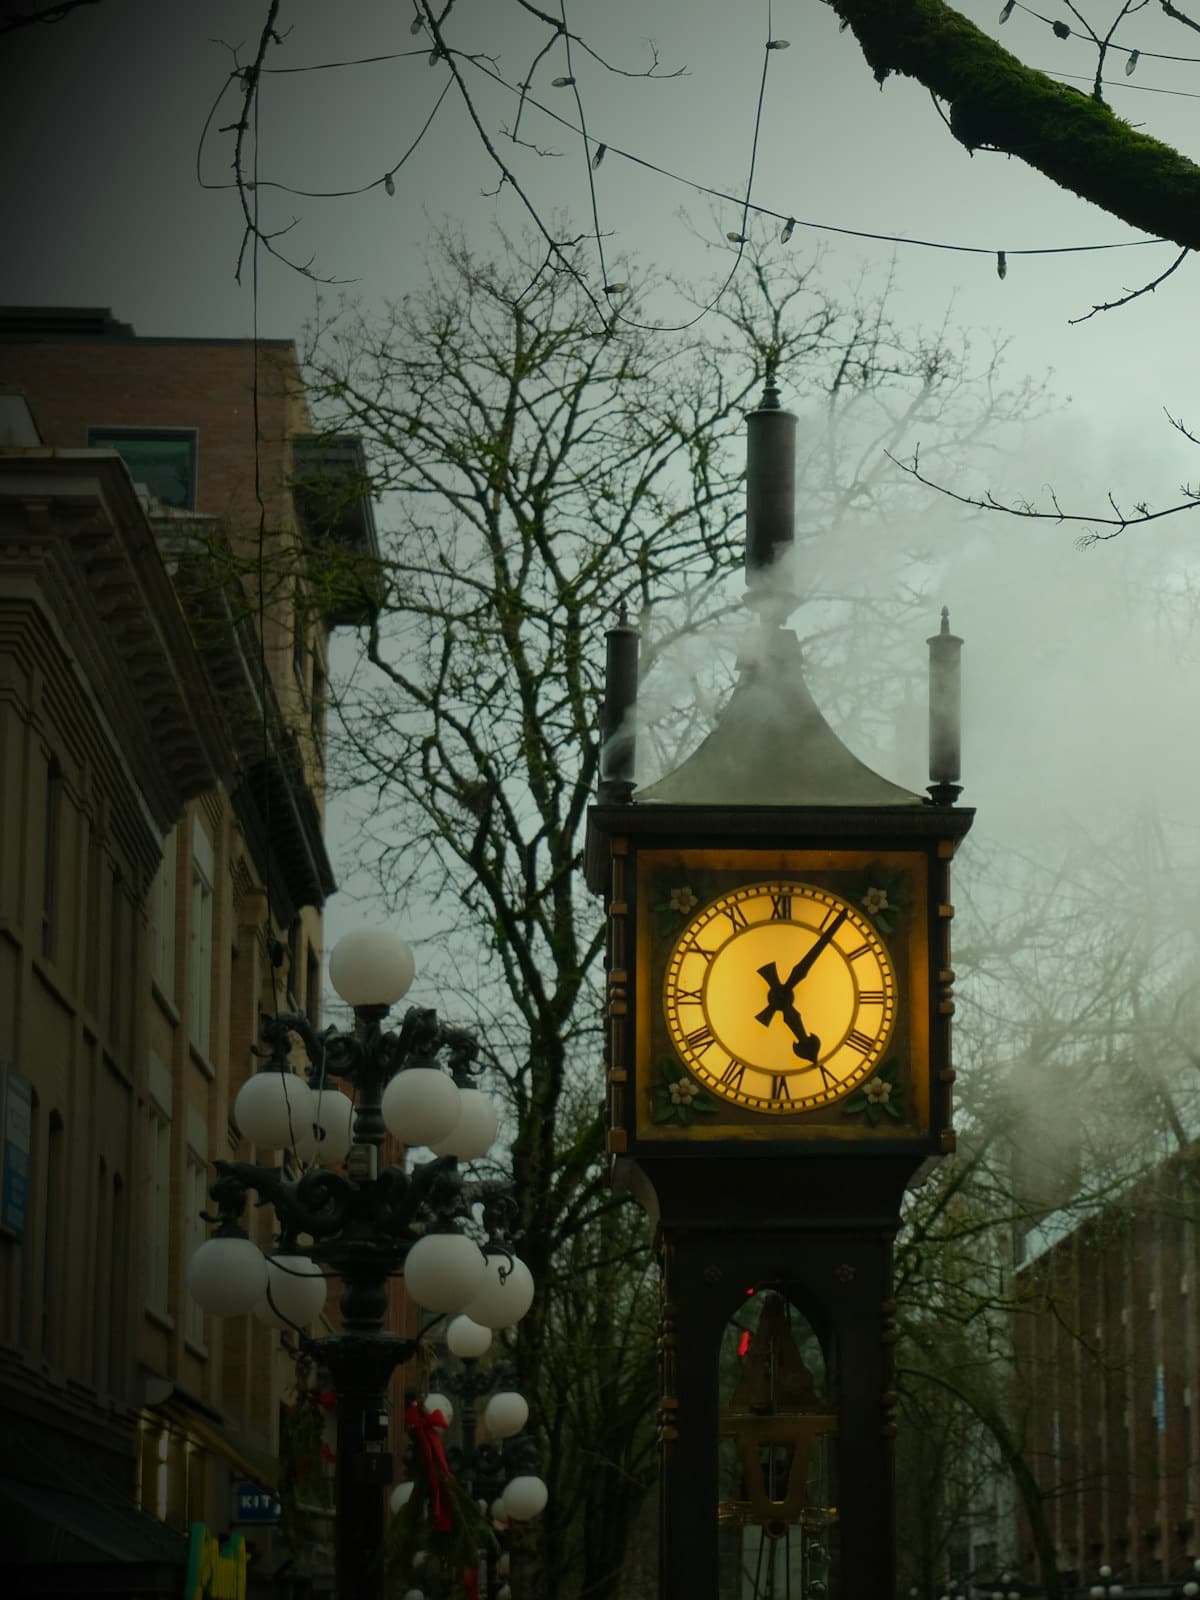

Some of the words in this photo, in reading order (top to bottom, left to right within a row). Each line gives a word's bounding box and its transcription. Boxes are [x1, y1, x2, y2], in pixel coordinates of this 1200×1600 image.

[723, 904, 749, 933] XI
[769, 895, 792, 920] XII
[688, 939, 716, 964] X
[846, 943, 873, 961] II
[677, 989, 702, 1005] IX
[859, 991, 884, 1004] III
[686, 1025, 716, 1058] VIII
[721, 1060, 745, 1092] VII
[772, 1076, 790, 1100] VI
[820, 1065, 839, 1089] V
